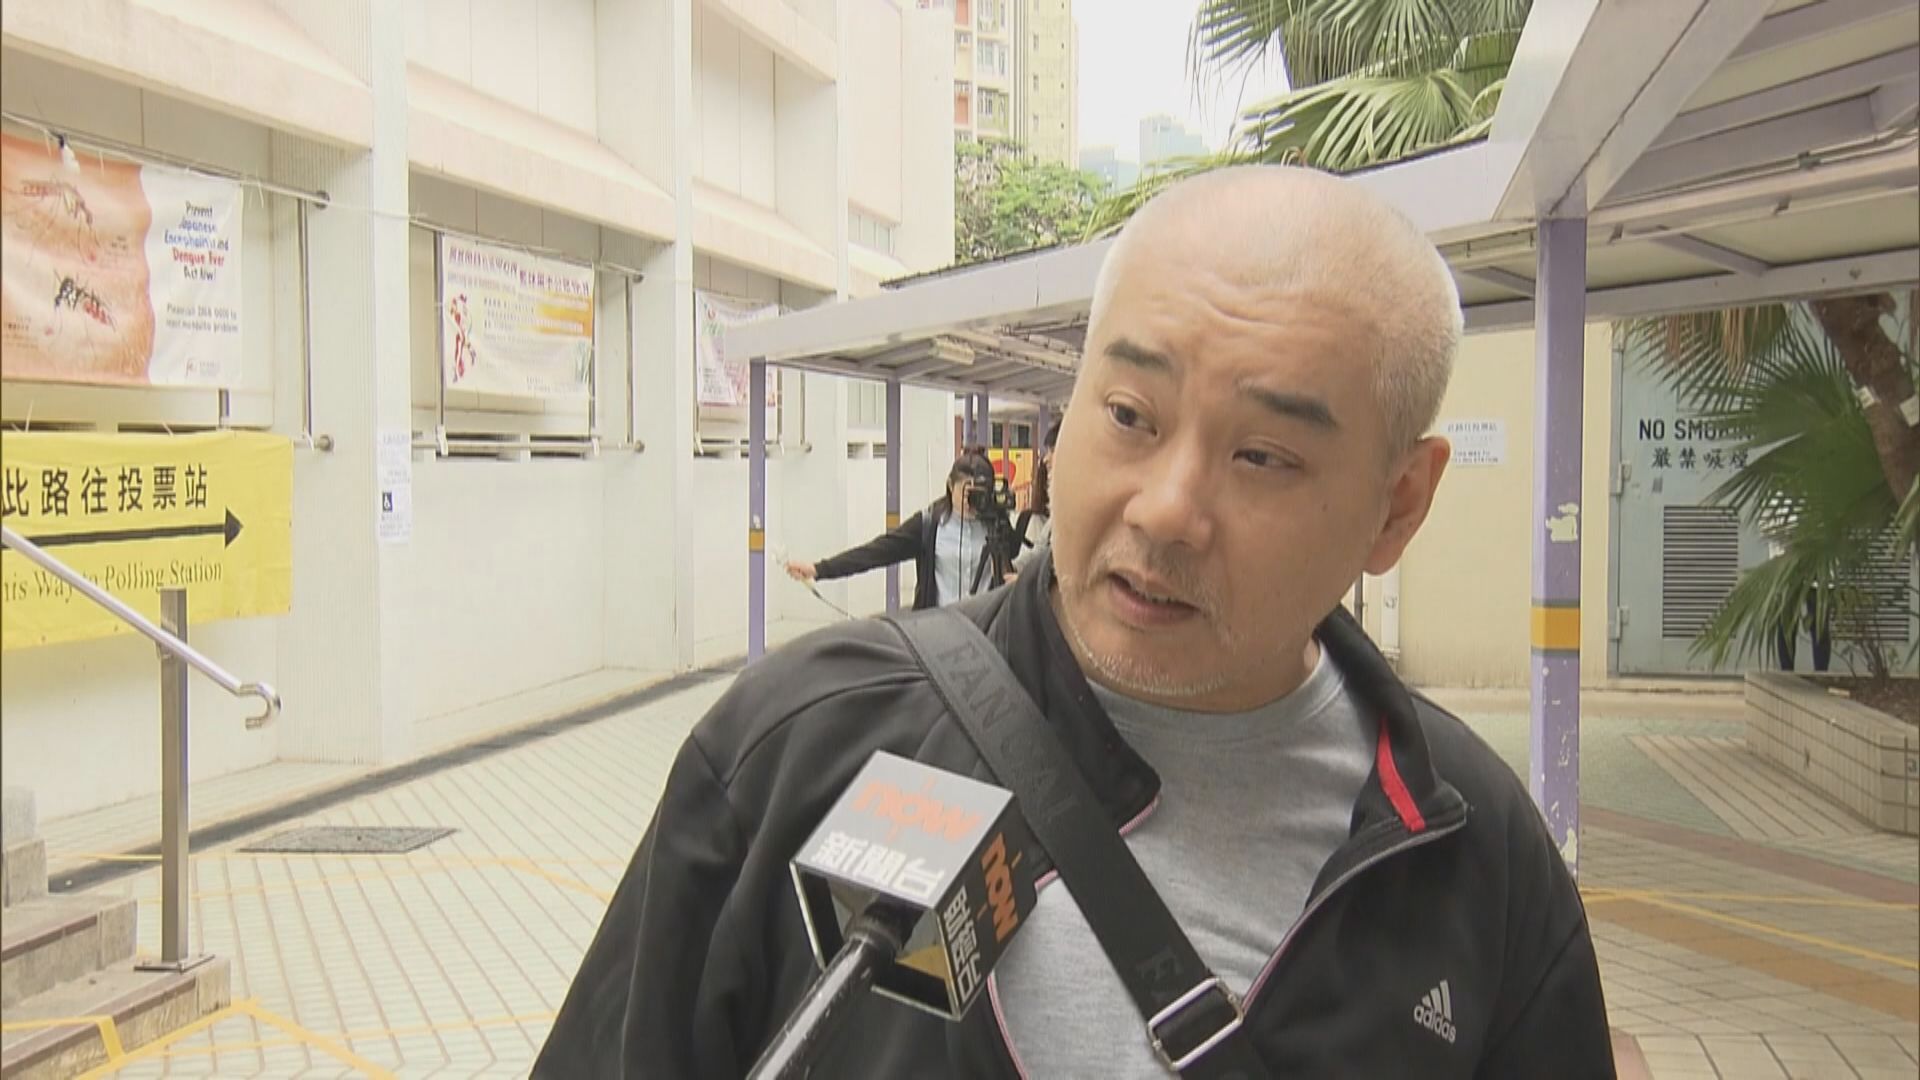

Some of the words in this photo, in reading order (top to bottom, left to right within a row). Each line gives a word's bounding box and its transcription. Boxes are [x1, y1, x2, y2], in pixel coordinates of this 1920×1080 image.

[172, 247, 205, 266] Dengue
[1640, 419, 1665, 440] NO
[2, 464, 208, 517] 此路往投票站
[105, 561, 164, 593] Polling
[169, 556, 223, 585] Station
[852, 776, 984, 841] now
[810, 831, 945, 898] 新聞台
[978, 831, 1023, 942] now
[1413, 1004, 1457, 1044] adidas
